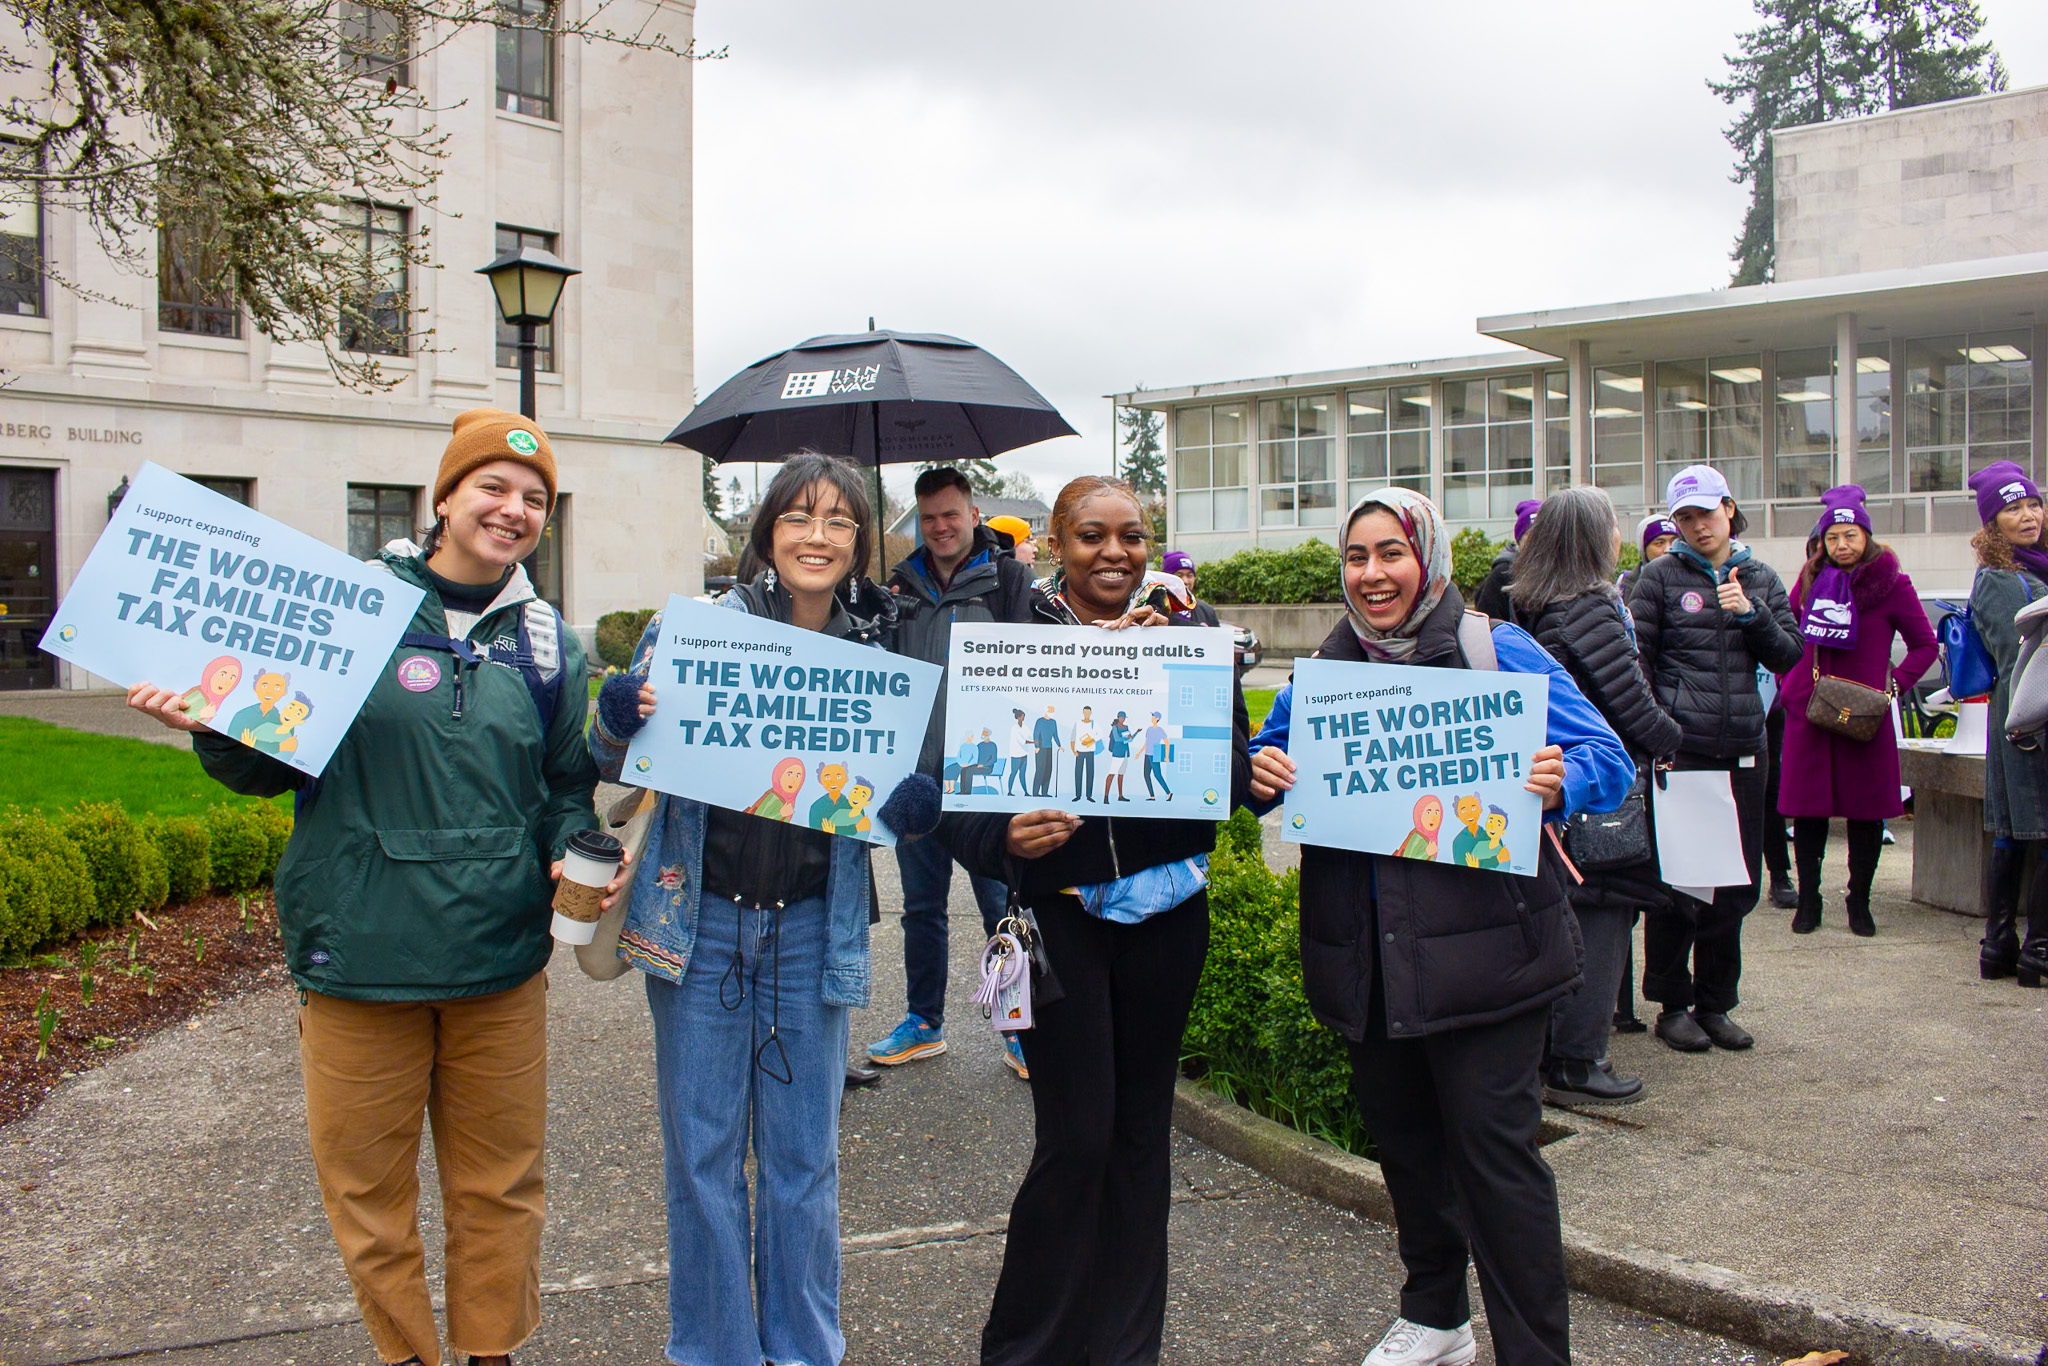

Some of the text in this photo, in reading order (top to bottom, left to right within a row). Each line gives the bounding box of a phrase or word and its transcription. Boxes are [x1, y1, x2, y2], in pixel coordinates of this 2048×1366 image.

[835, 364, 880, 379] INN
[853, 373, 878, 383] THE
[831, 381, 875, 394] WAC
[68, 427, 142, 445] BUILDING
[136, 503, 262, 548] I support expanding
[127, 527, 385, 617] THE WORKING
[150, 568, 334, 636] FAMILIES
[116, 592, 355, 676] TAX CREDIT!
[1804, 624, 1850, 639] SEIU 775
[674, 635, 792, 656] I support expanding
[963, 640, 1205, 660] Seniors and young adults
[672, 659, 911, 697] THE WORKING
[962, 664, 1139, 680] need a cash boost!
[960, 685, 980, 693] LET'S
[1031, 686, 1070, 694] WORKING
[1071, 687, 1107, 695] FAMILIES
[1125, 688, 1153, 696] CREDIT
[1305, 685, 1412, 706] I support expanding
[707, 691, 872, 724] FAMILIES
[1307, 689, 1524, 741] THE WORKING
[679, 720, 896, 755] TAX CREDIT!
[1343, 725, 1495, 767] FAMILIES
[1323, 752, 1521, 797] TAX CREDIT!
